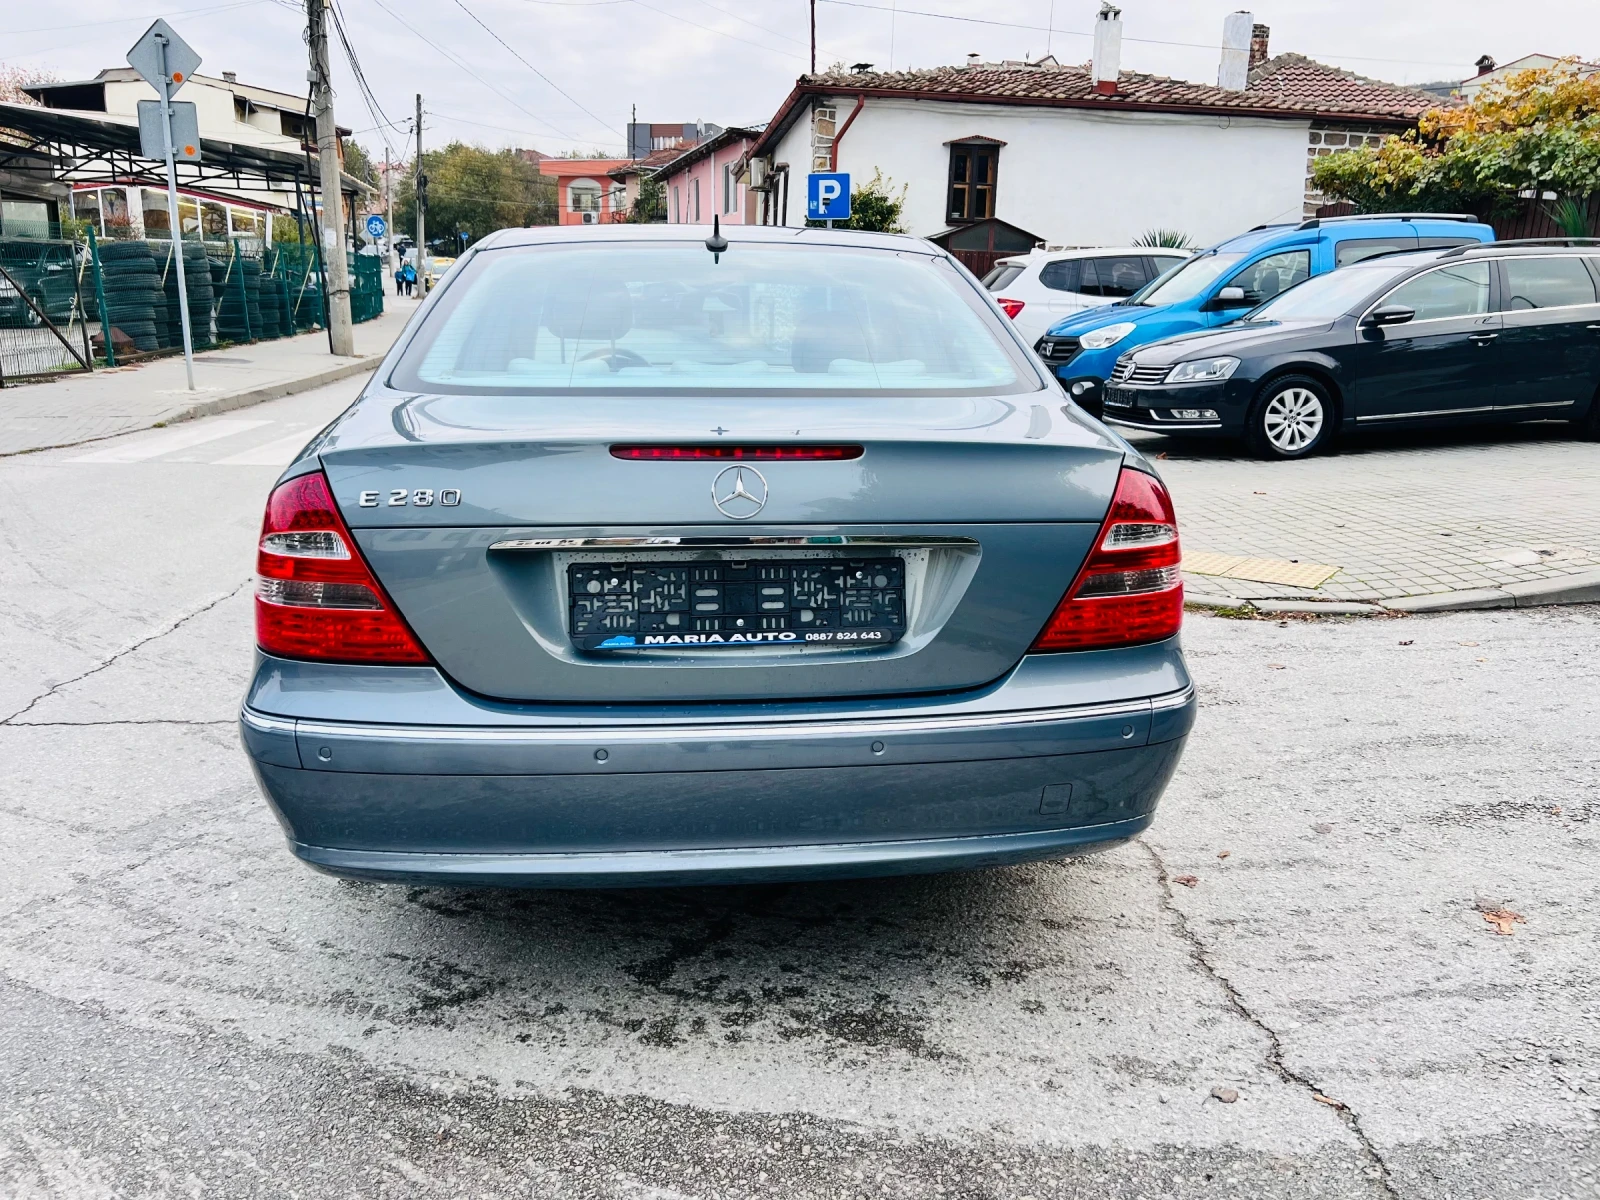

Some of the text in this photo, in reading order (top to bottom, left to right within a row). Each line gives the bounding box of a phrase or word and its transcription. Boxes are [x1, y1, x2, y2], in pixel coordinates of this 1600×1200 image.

[819, 179, 841, 214] P
[359, 488, 462, 507] E 280
[644, 631, 882, 645] MARIA AUTO 0887 824 643
